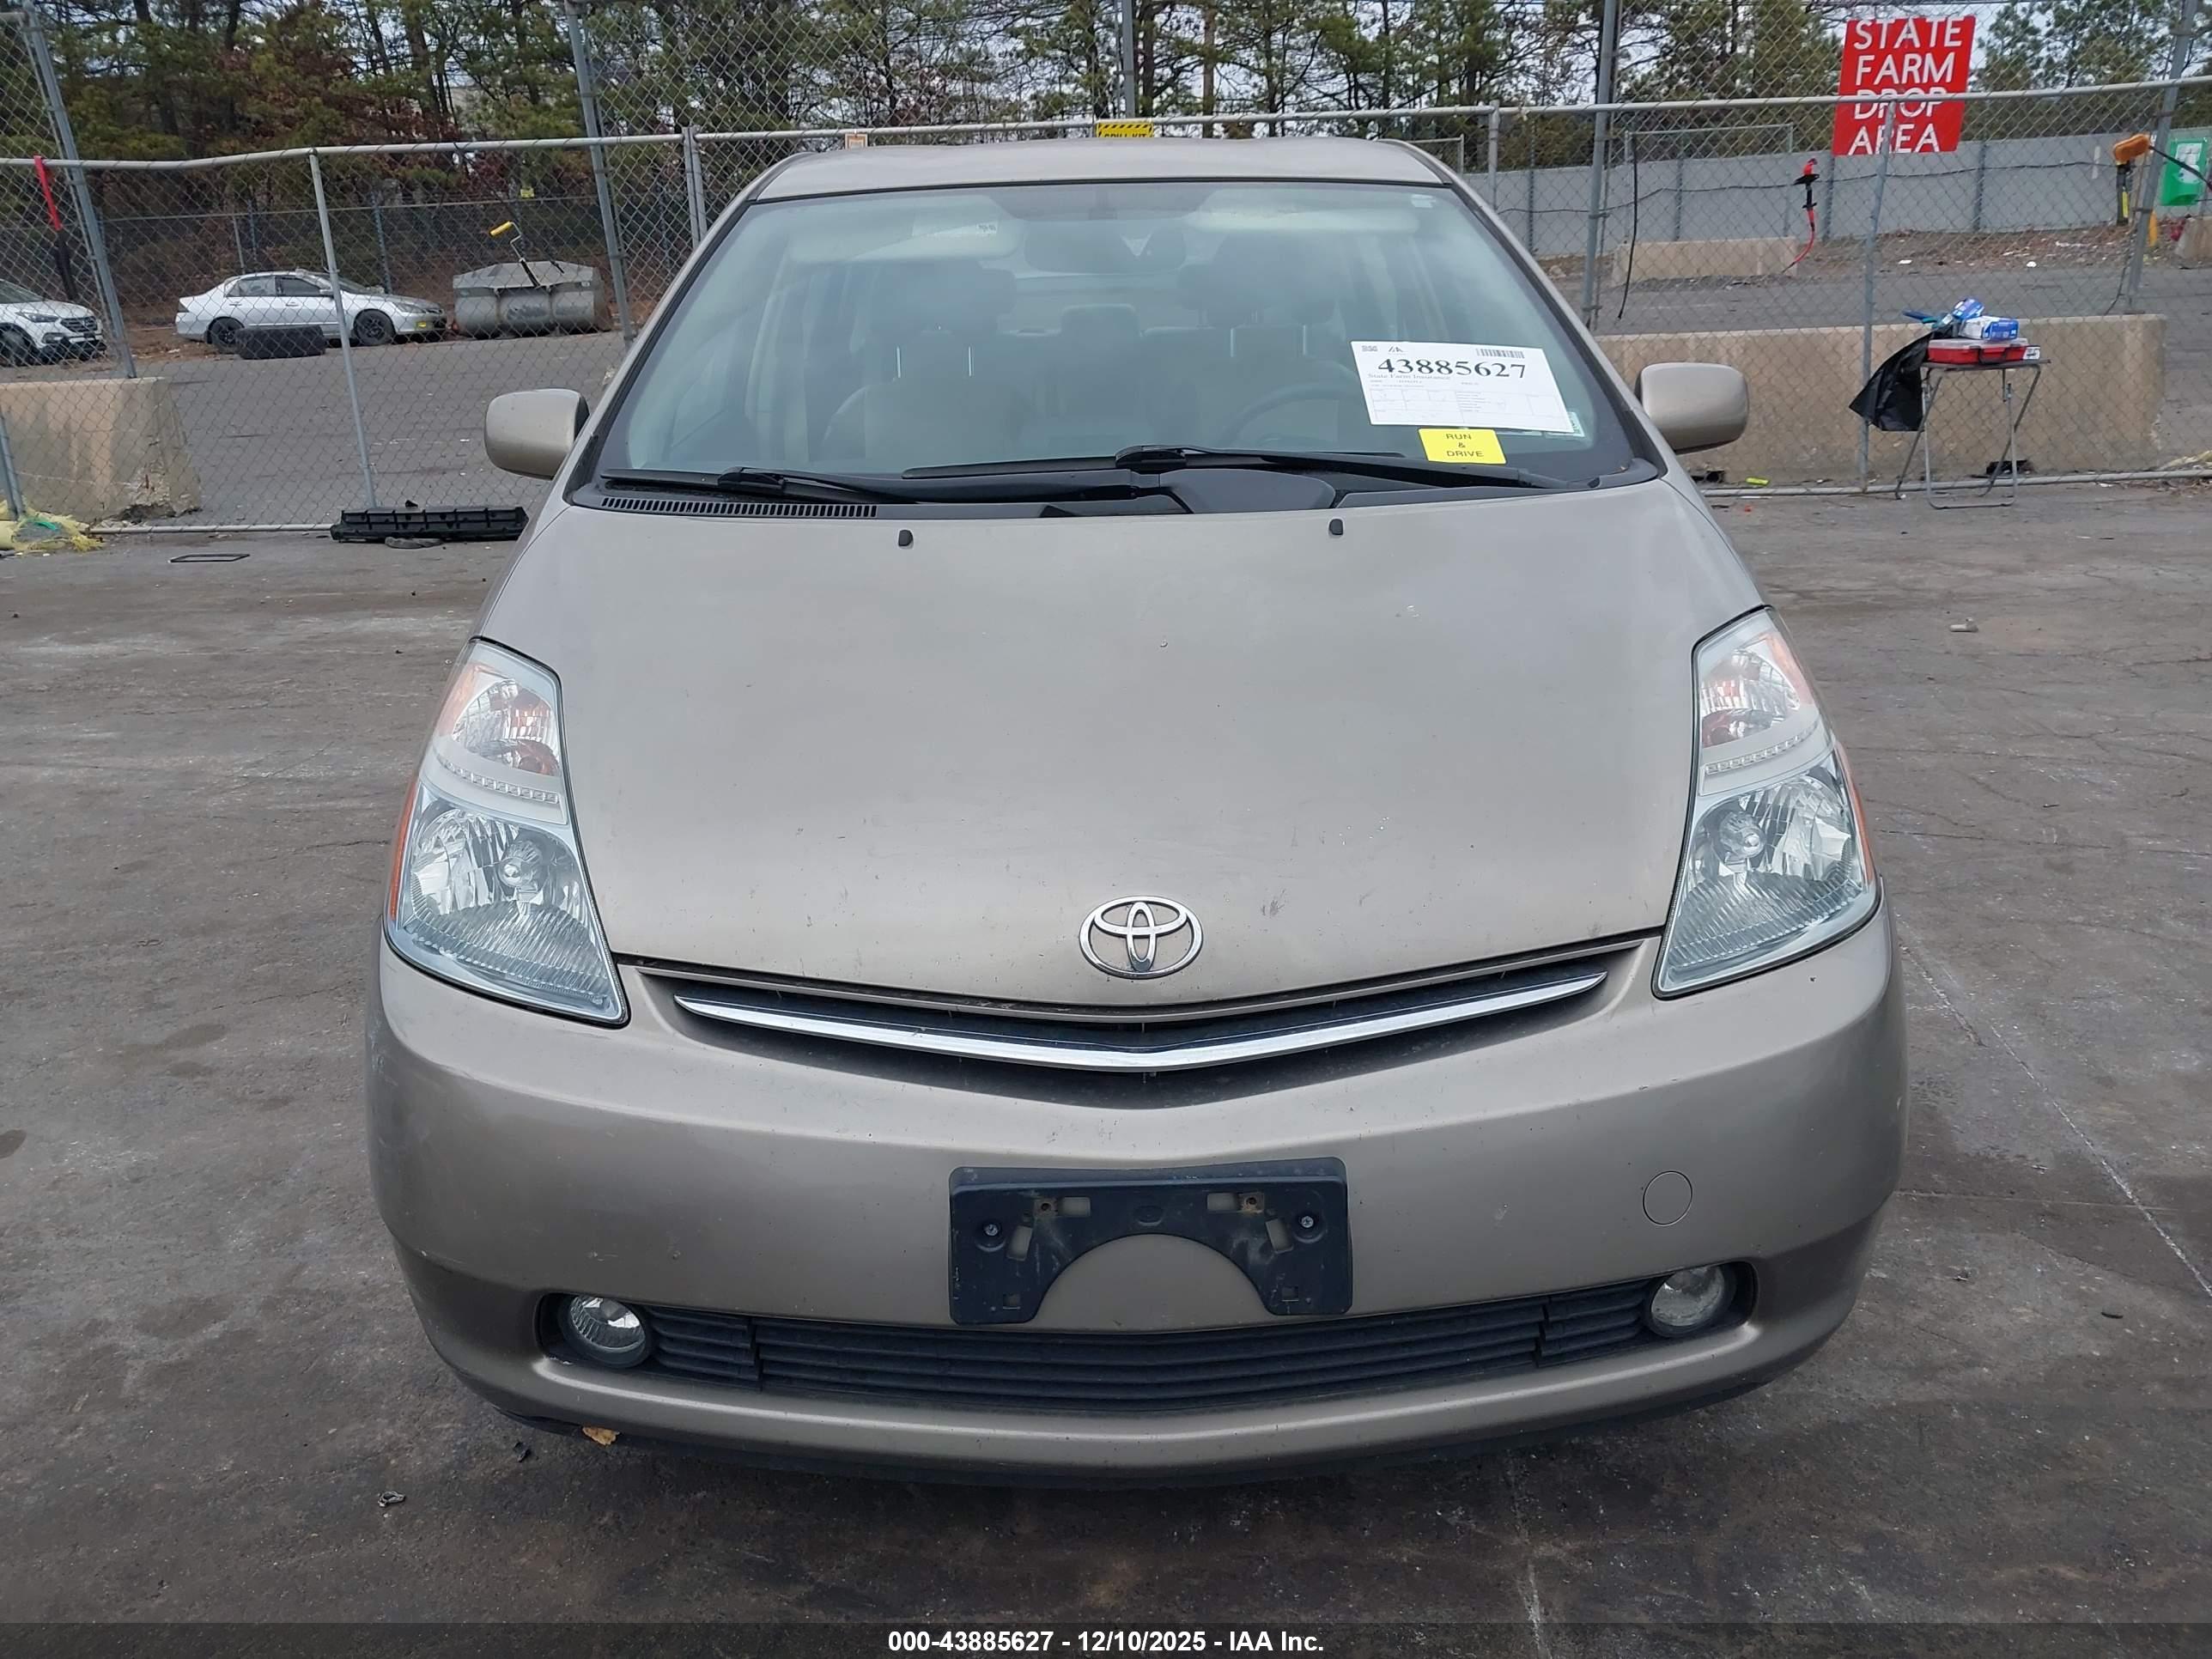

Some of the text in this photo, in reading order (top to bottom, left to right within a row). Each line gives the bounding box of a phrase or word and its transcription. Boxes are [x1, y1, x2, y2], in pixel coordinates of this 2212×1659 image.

[1854, 17, 1965, 49] STATE
[1856, 52, 1955, 85] FARM
[1378, 358, 1526, 379] 43885627
